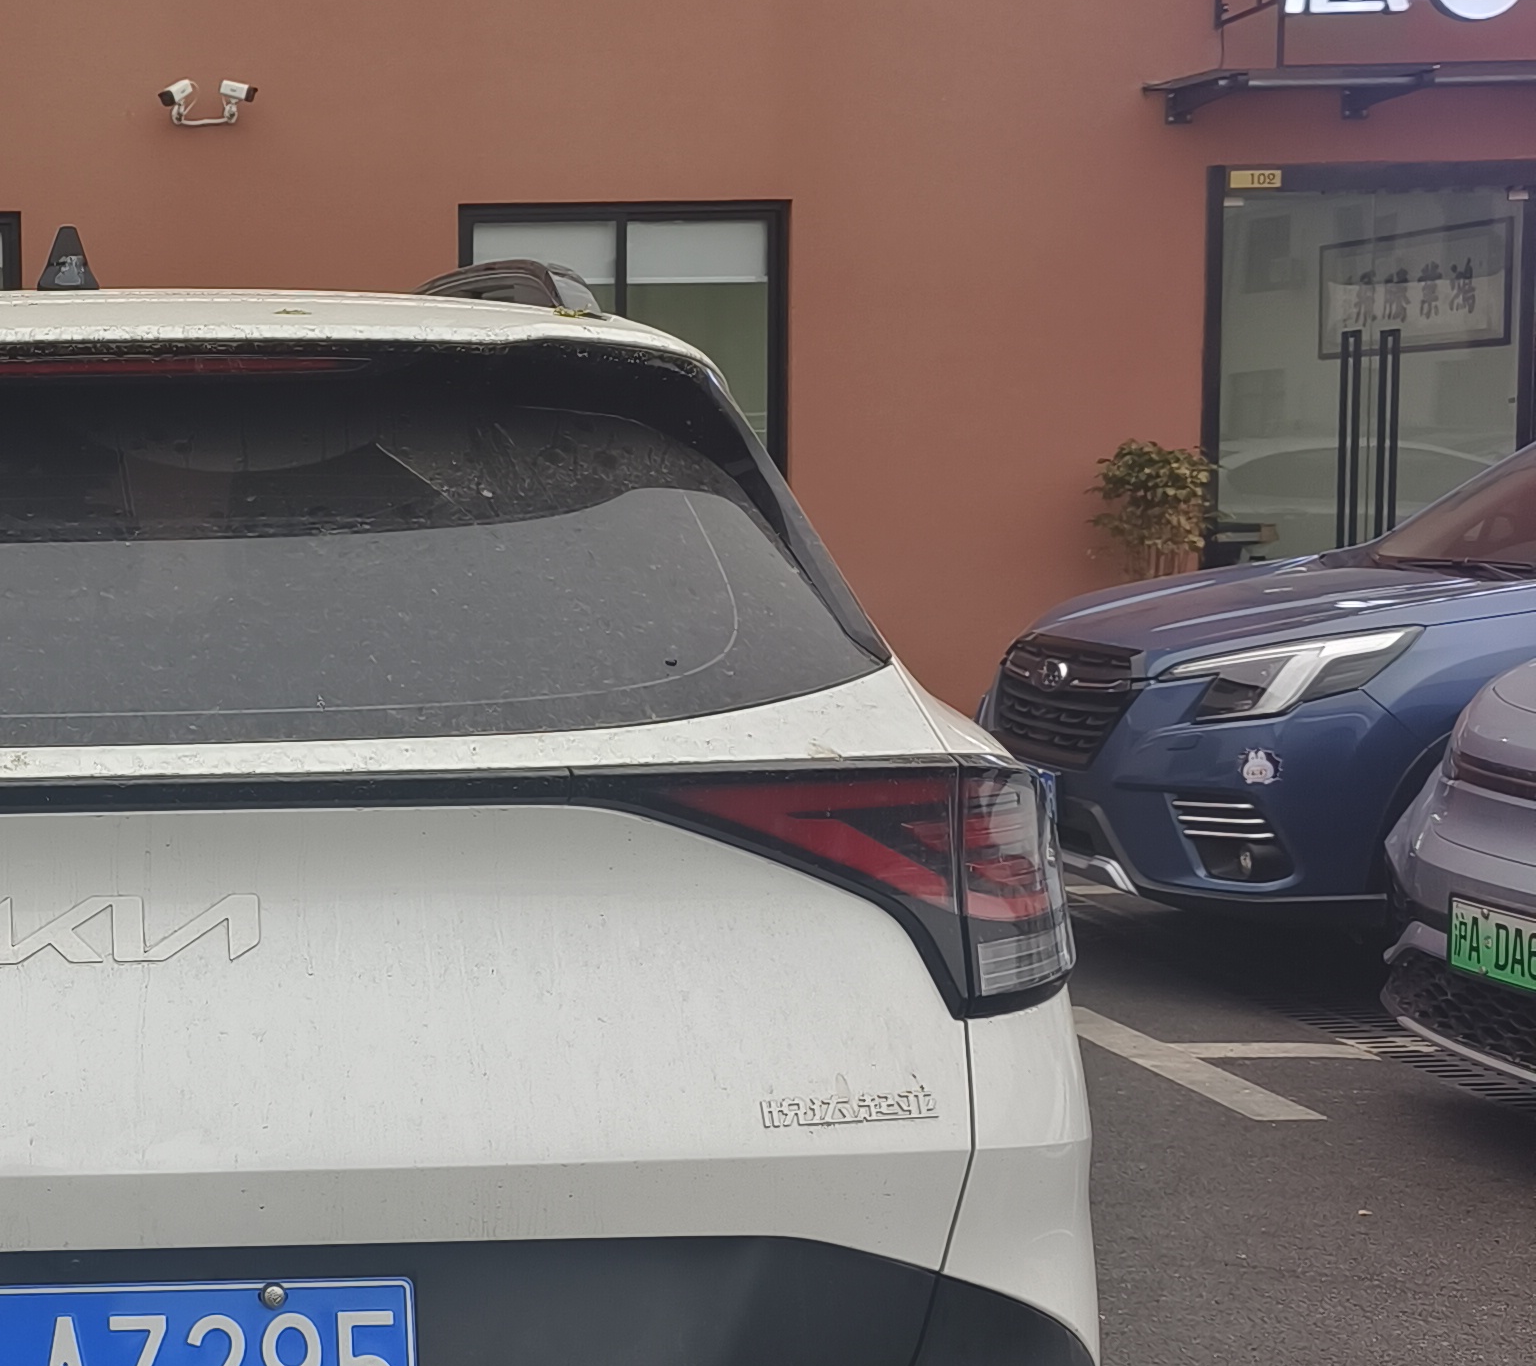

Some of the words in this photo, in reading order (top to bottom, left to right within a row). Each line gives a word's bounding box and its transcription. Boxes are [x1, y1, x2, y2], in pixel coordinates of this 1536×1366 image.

[1249, 172, 1277, 186] 102
[760, 1091, 940, 1129] 悦达起亚
